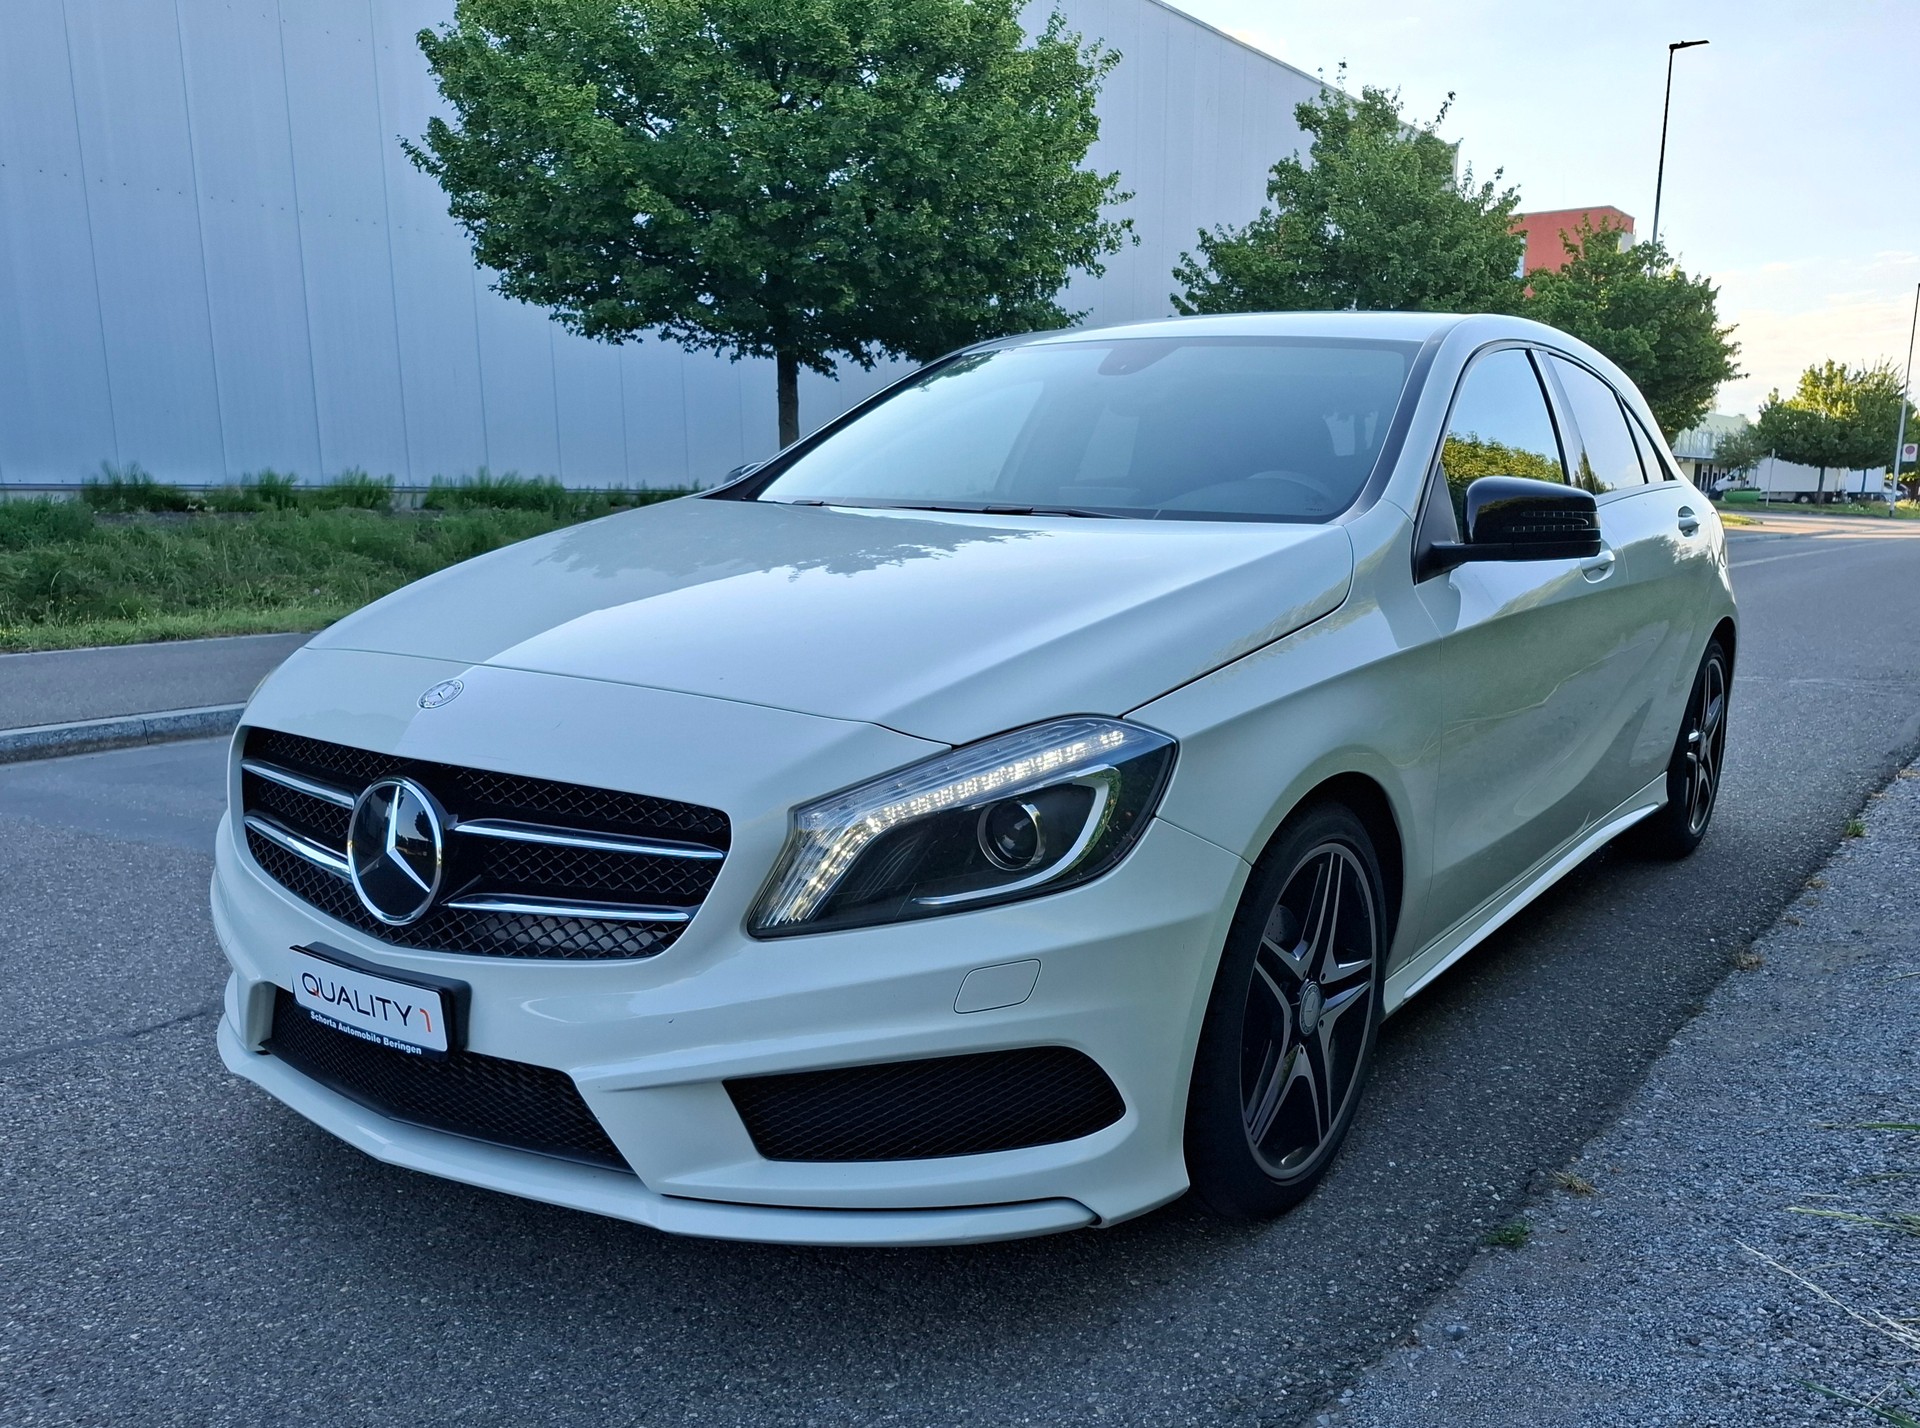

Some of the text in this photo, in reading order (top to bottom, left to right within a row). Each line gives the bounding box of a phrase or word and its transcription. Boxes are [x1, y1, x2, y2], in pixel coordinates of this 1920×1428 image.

[302, 972, 432, 1033] QUALITY 1
[338, 1022, 381, 1044] Automobile
[383, 1036, 422, 1055] Beringen
